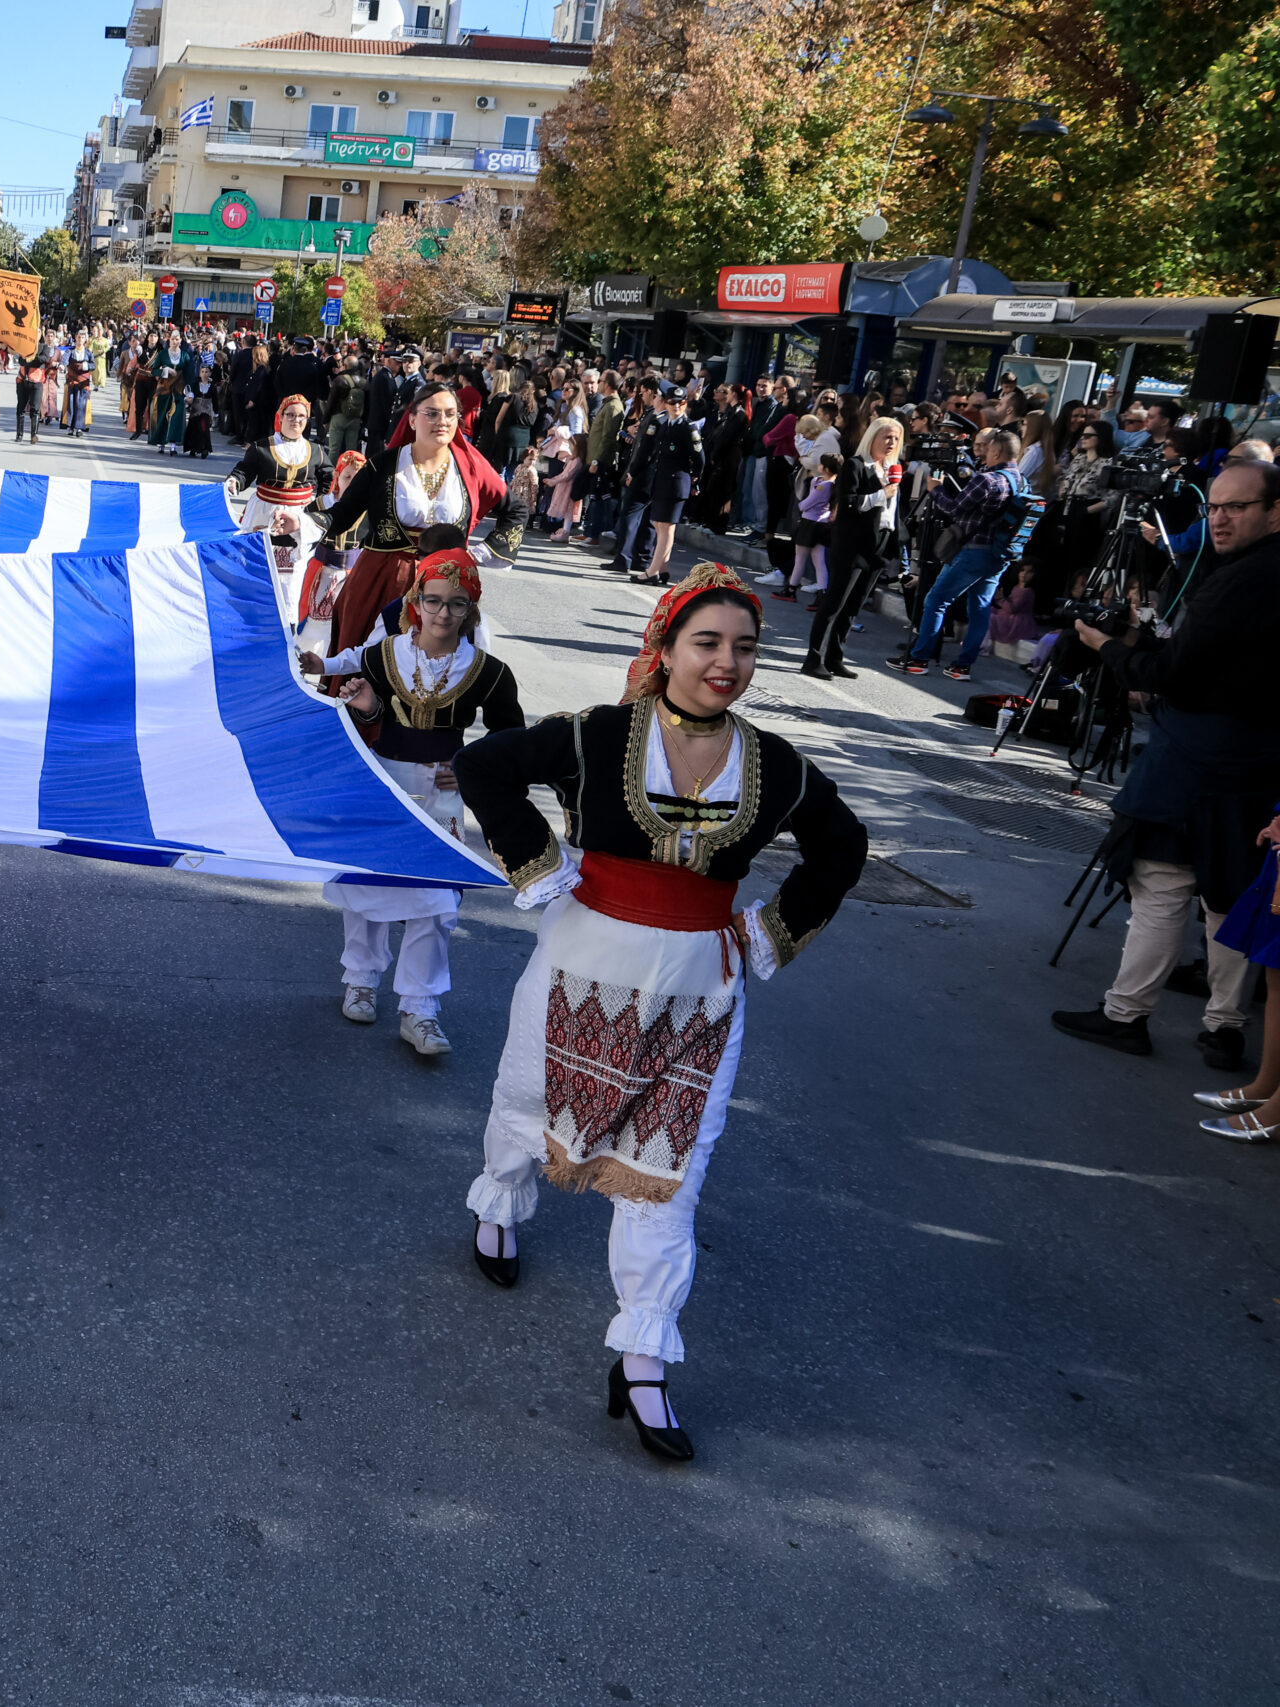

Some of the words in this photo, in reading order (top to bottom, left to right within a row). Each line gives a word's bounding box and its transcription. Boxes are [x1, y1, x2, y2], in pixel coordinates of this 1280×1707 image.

[728, 279, 781, 297] EXALCO
[797, 277, 826, 287] ΣΥΣΤΗΜΑΤΑ
[606, 286, 642, 306] Βιοκαρπέτ
[795, 289, 825, 299] ΑΛΟΥΜΙΝΙΟΥ
